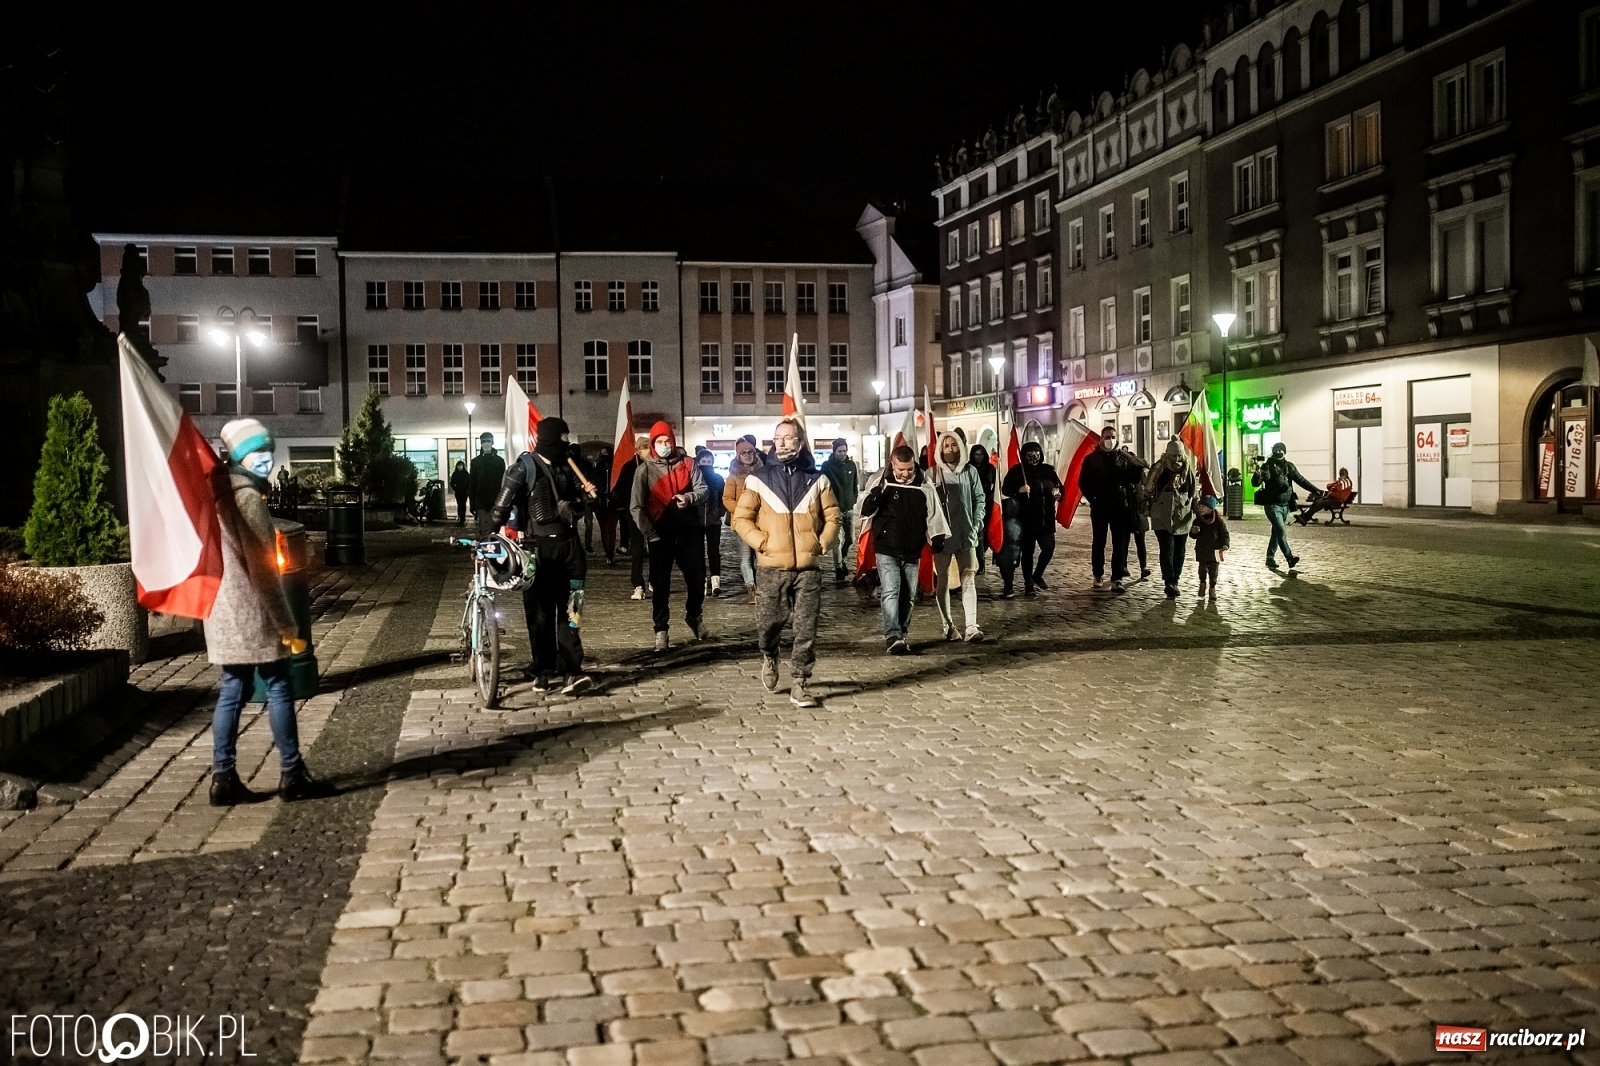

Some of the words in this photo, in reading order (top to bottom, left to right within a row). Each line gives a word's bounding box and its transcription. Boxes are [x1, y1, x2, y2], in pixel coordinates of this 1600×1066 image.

[1112, 380, 1136, 396] SHIRO
[1573, 423, 1585, 446] 432
[1569, 447, 1582, 469] 716
[1540, 449, 1555, 490] WYNAJMĘ
[1566, 471, 1578, 493] 602
